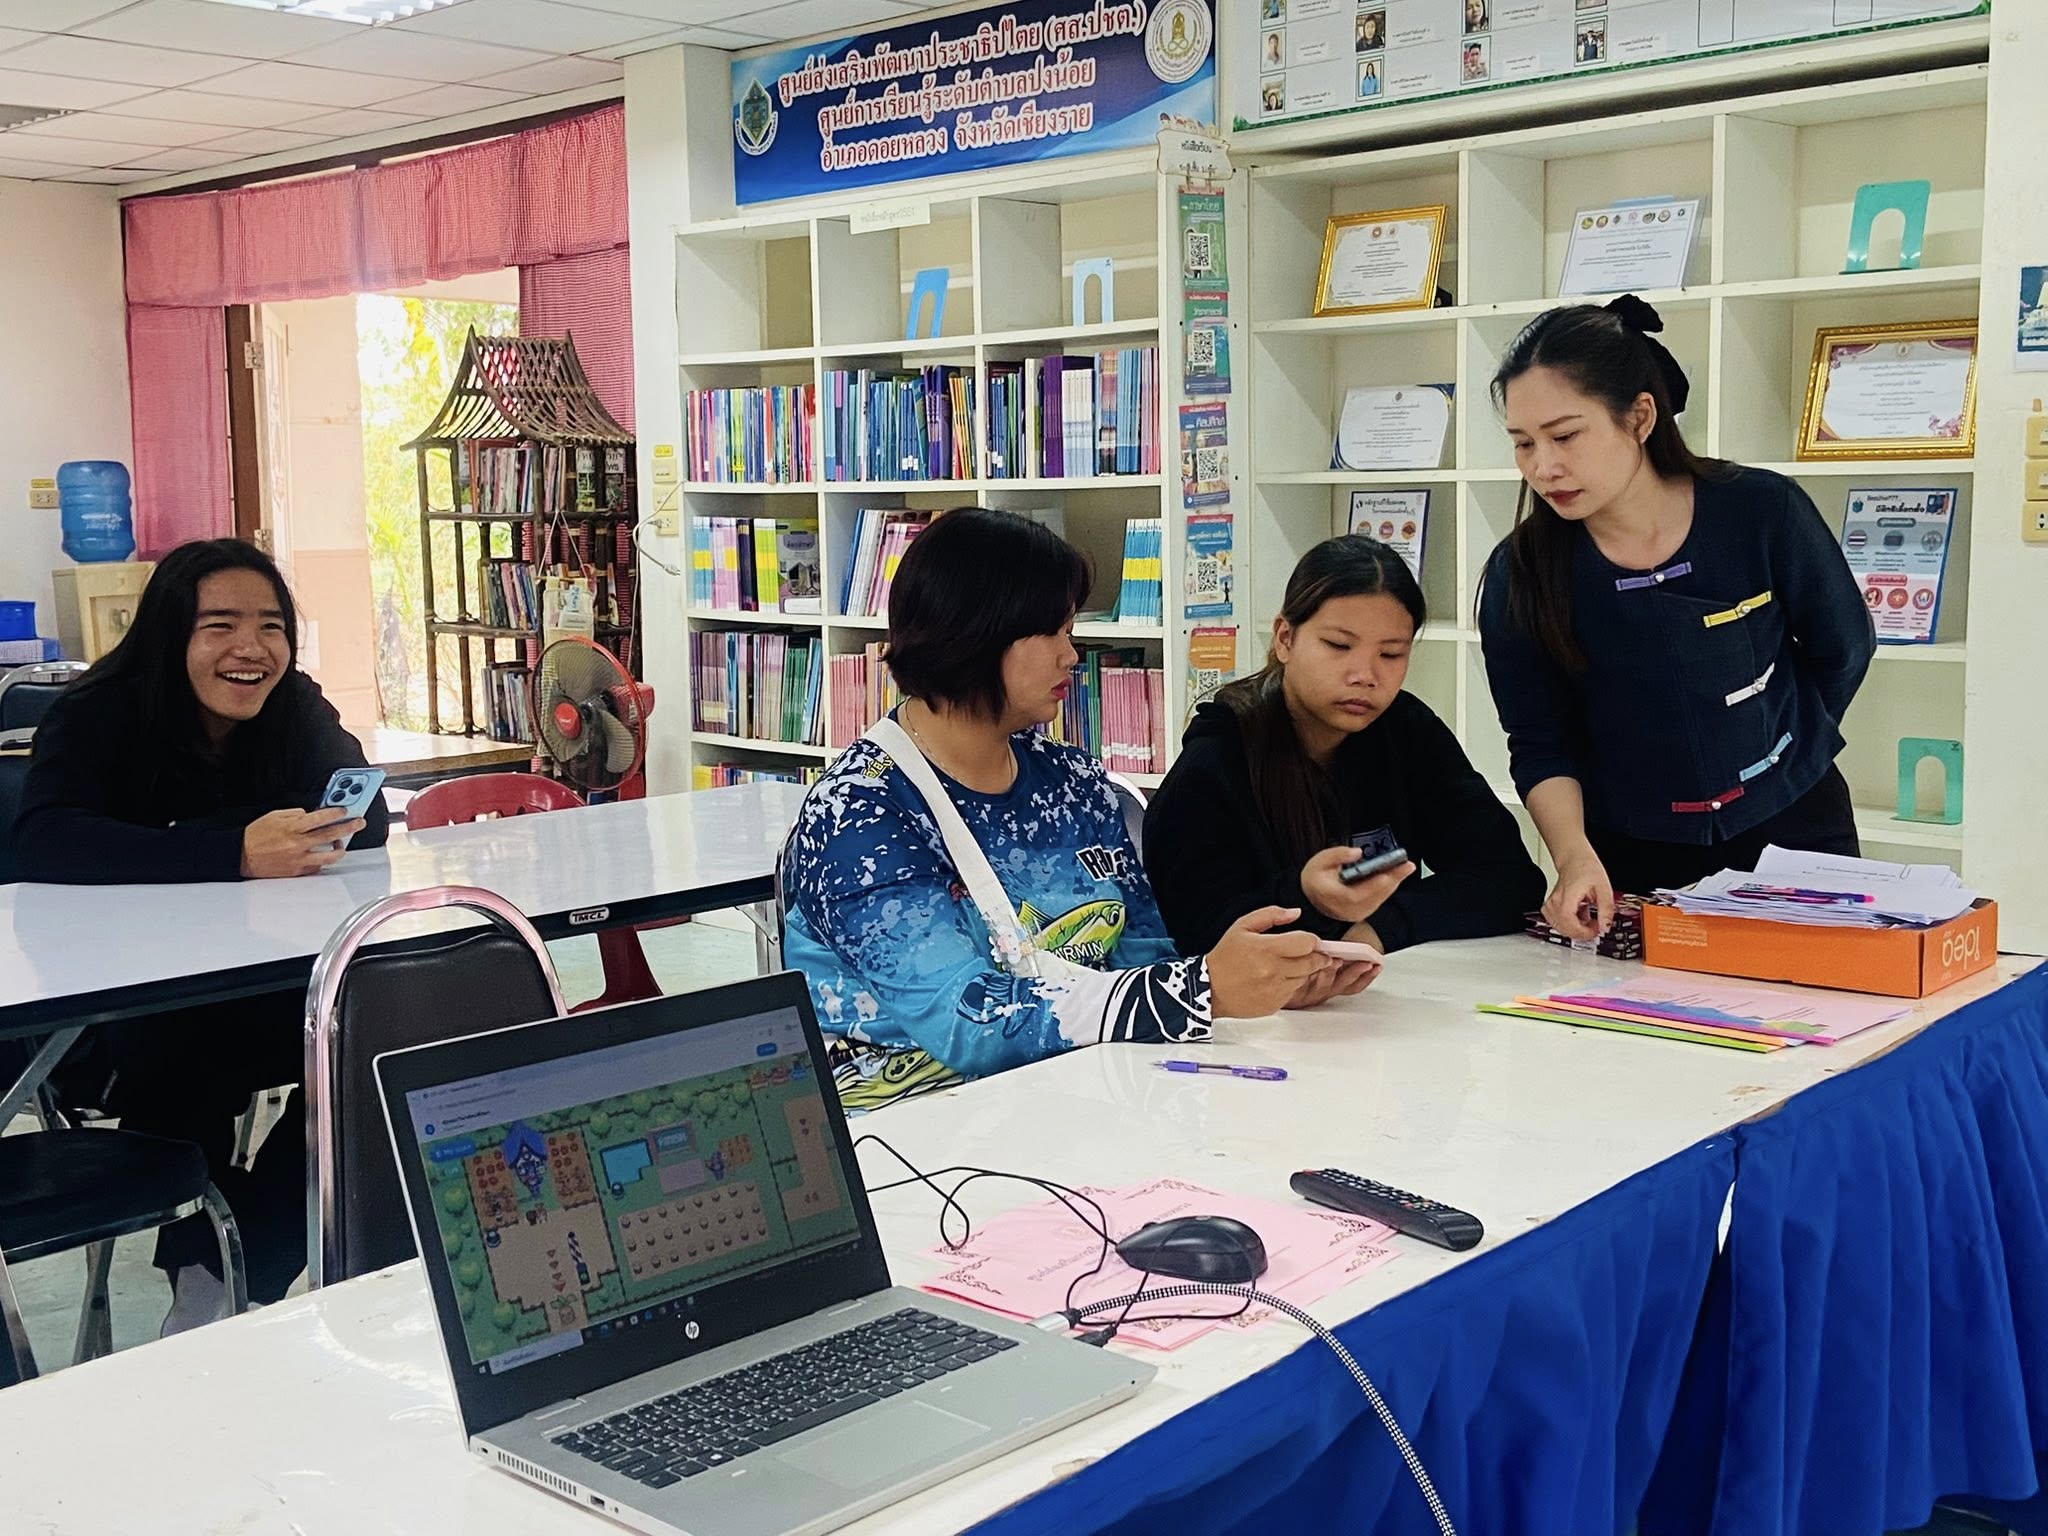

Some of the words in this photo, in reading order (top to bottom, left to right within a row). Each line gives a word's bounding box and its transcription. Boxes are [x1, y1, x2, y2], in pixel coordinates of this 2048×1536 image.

[819, 50, 1095, 137] ศูนย์การเรียนรู้ระดับตำบลปงน้อย
[822, 128, 947, 170] อำเภอดอยหลวง
[955, 103, 1092, 148] จังหวัดเชียงราย
[572, 909, 605, 923] TMCL
